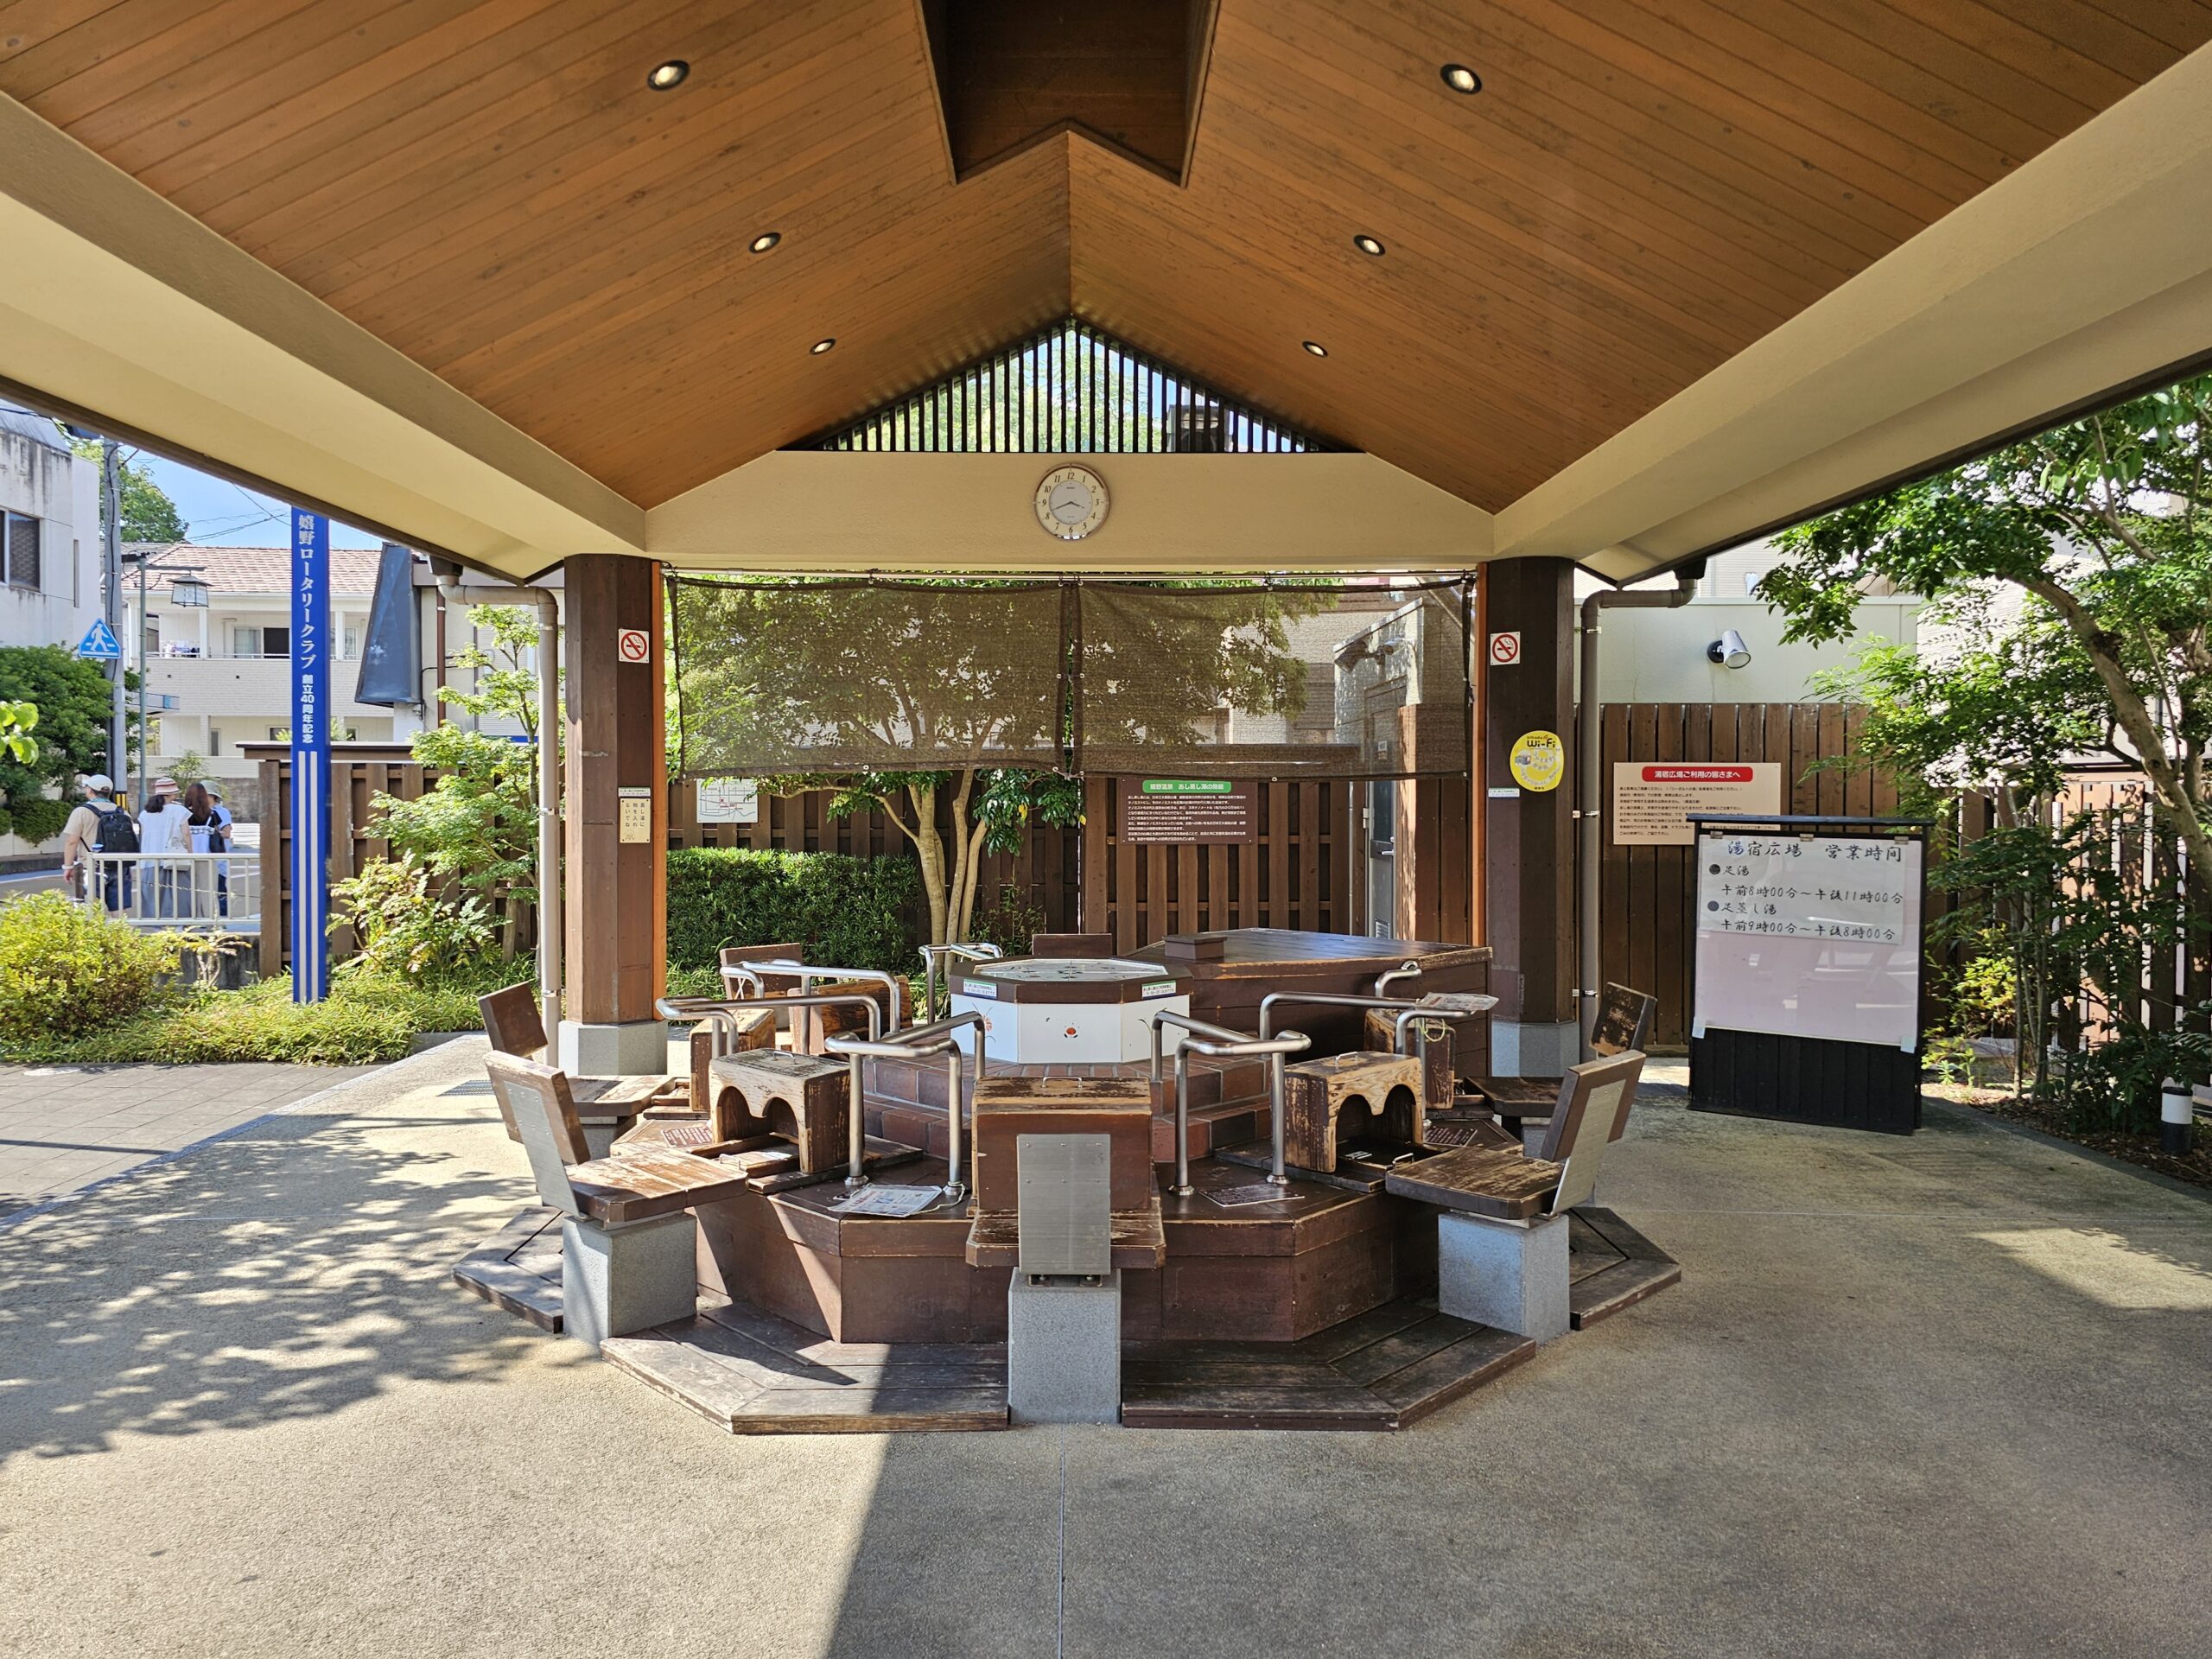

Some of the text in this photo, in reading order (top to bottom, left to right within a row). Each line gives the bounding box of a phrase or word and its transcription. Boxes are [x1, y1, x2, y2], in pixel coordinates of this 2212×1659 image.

[298, 514, 316, 744] 嬉野ロータリークラブ 創立40周年記念
[1654, 770, 1741, 779] 湯宿広場ご利用の皆さまへ
[1727, 841, 1903, 862] 湯宿広場 営業時間
[1722, 865, 1750, 876] 足湯
[1720, 902, 1777, 915] 足蒸し湯
